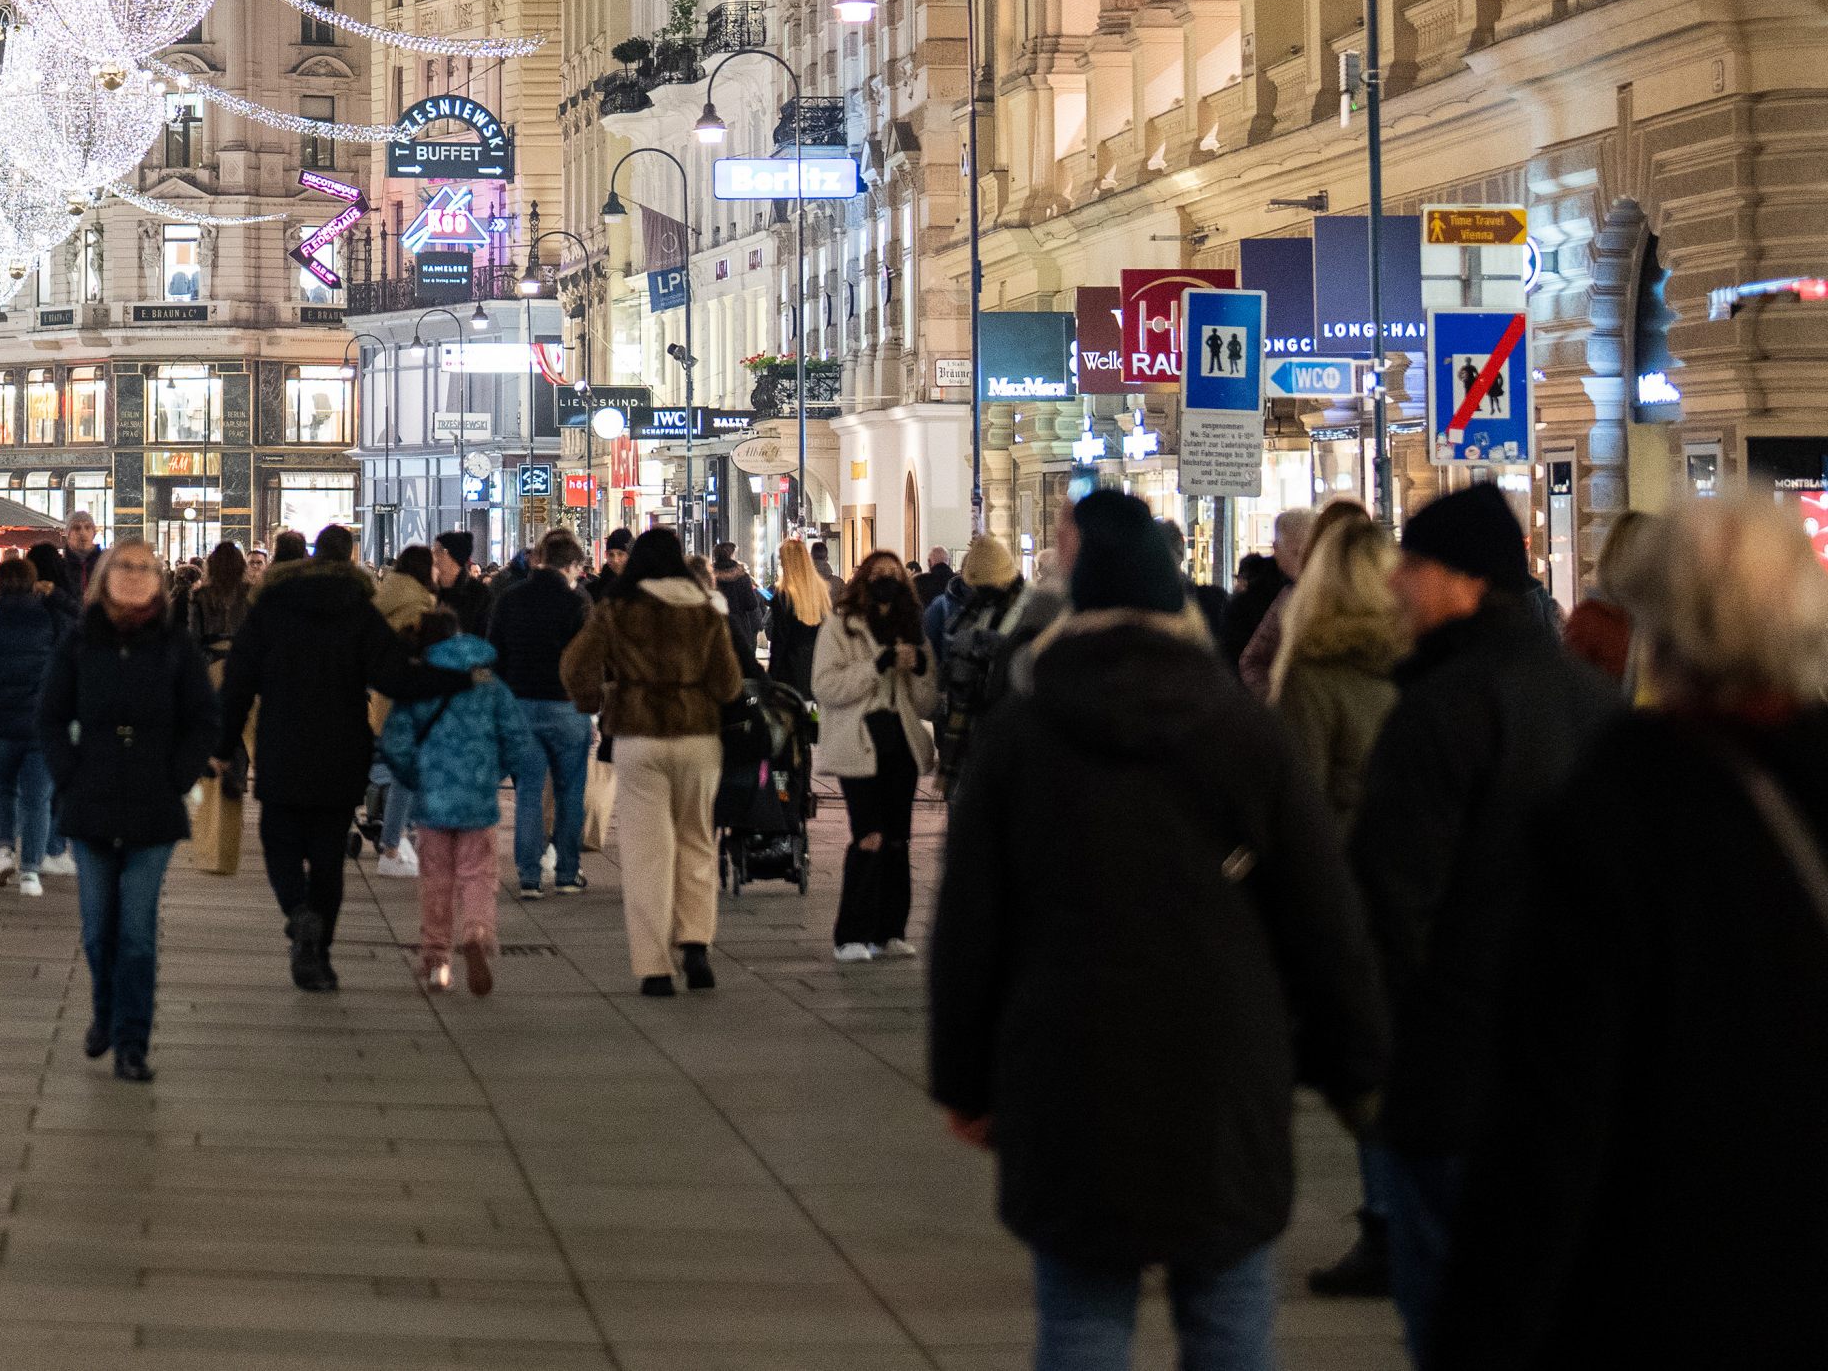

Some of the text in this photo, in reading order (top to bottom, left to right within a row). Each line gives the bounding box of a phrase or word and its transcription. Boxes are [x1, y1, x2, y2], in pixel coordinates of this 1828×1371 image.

[416, 146, 482, 161] BUFFET
[731, 163, 841, 191] Berlitz
[1450, 215, 1505, 226] Time Travel
[301, 208, 362, 258] FLEDERMAUS
[1460, 229, 1494, 240] Vienna
[151, 310, 179, 319] BRAUN
[1296, 367, 1323, 389] WC
[987, 377, 1068, 397] MaxMara
[653, 411, 686, 427] IWC
[713, 417, 750, 427] BALLY
[168, 456, 189, 471] H&M
